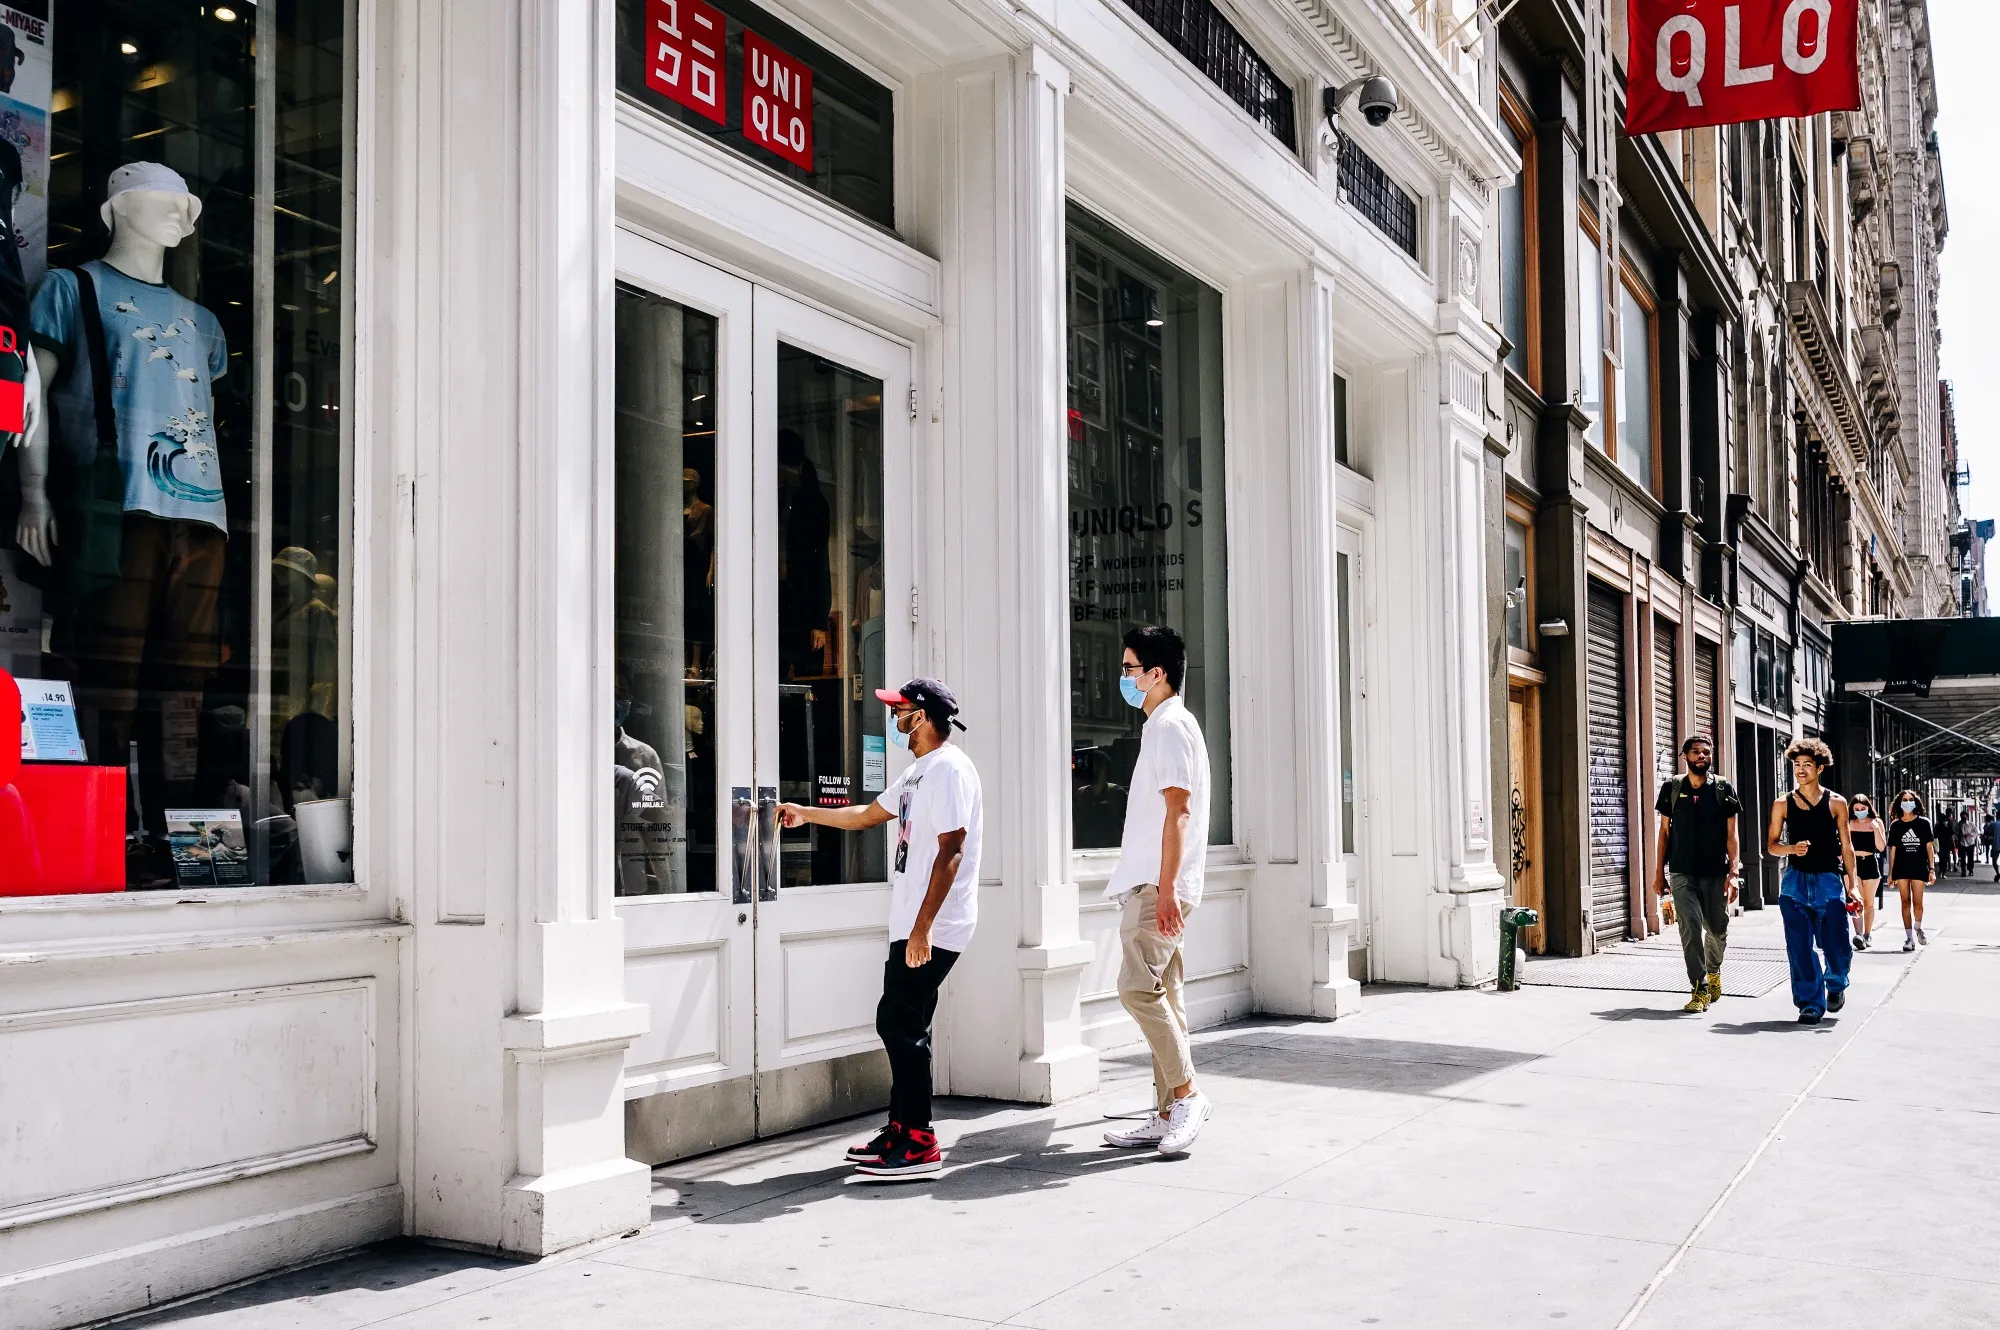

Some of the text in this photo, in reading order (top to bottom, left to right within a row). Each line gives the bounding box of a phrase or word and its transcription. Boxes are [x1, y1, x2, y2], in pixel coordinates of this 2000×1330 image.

[1656, 0, 1832, 107] QLO
[752, 47, 801, 110] UNI
[752, 95, 805, 153] QLO
[1072, 502, 1173, 539] UNIQLO
[1075, 556, 1094, 573] 2F
[1102, 556, 1146, 571] WOMEN
[1158, 554, 1185, 567] KIDS
[1077, 580, 1096, 598] 1F
[1102, 581, 1146, 596] WOMEN
[1159, 578, 1184, 592] MEN
[1074, 604, 1127, 622] BF MEN
[818, 776, 851, 786] FOLLOW US
[621, 822, 672, 832] STORE HOURS
